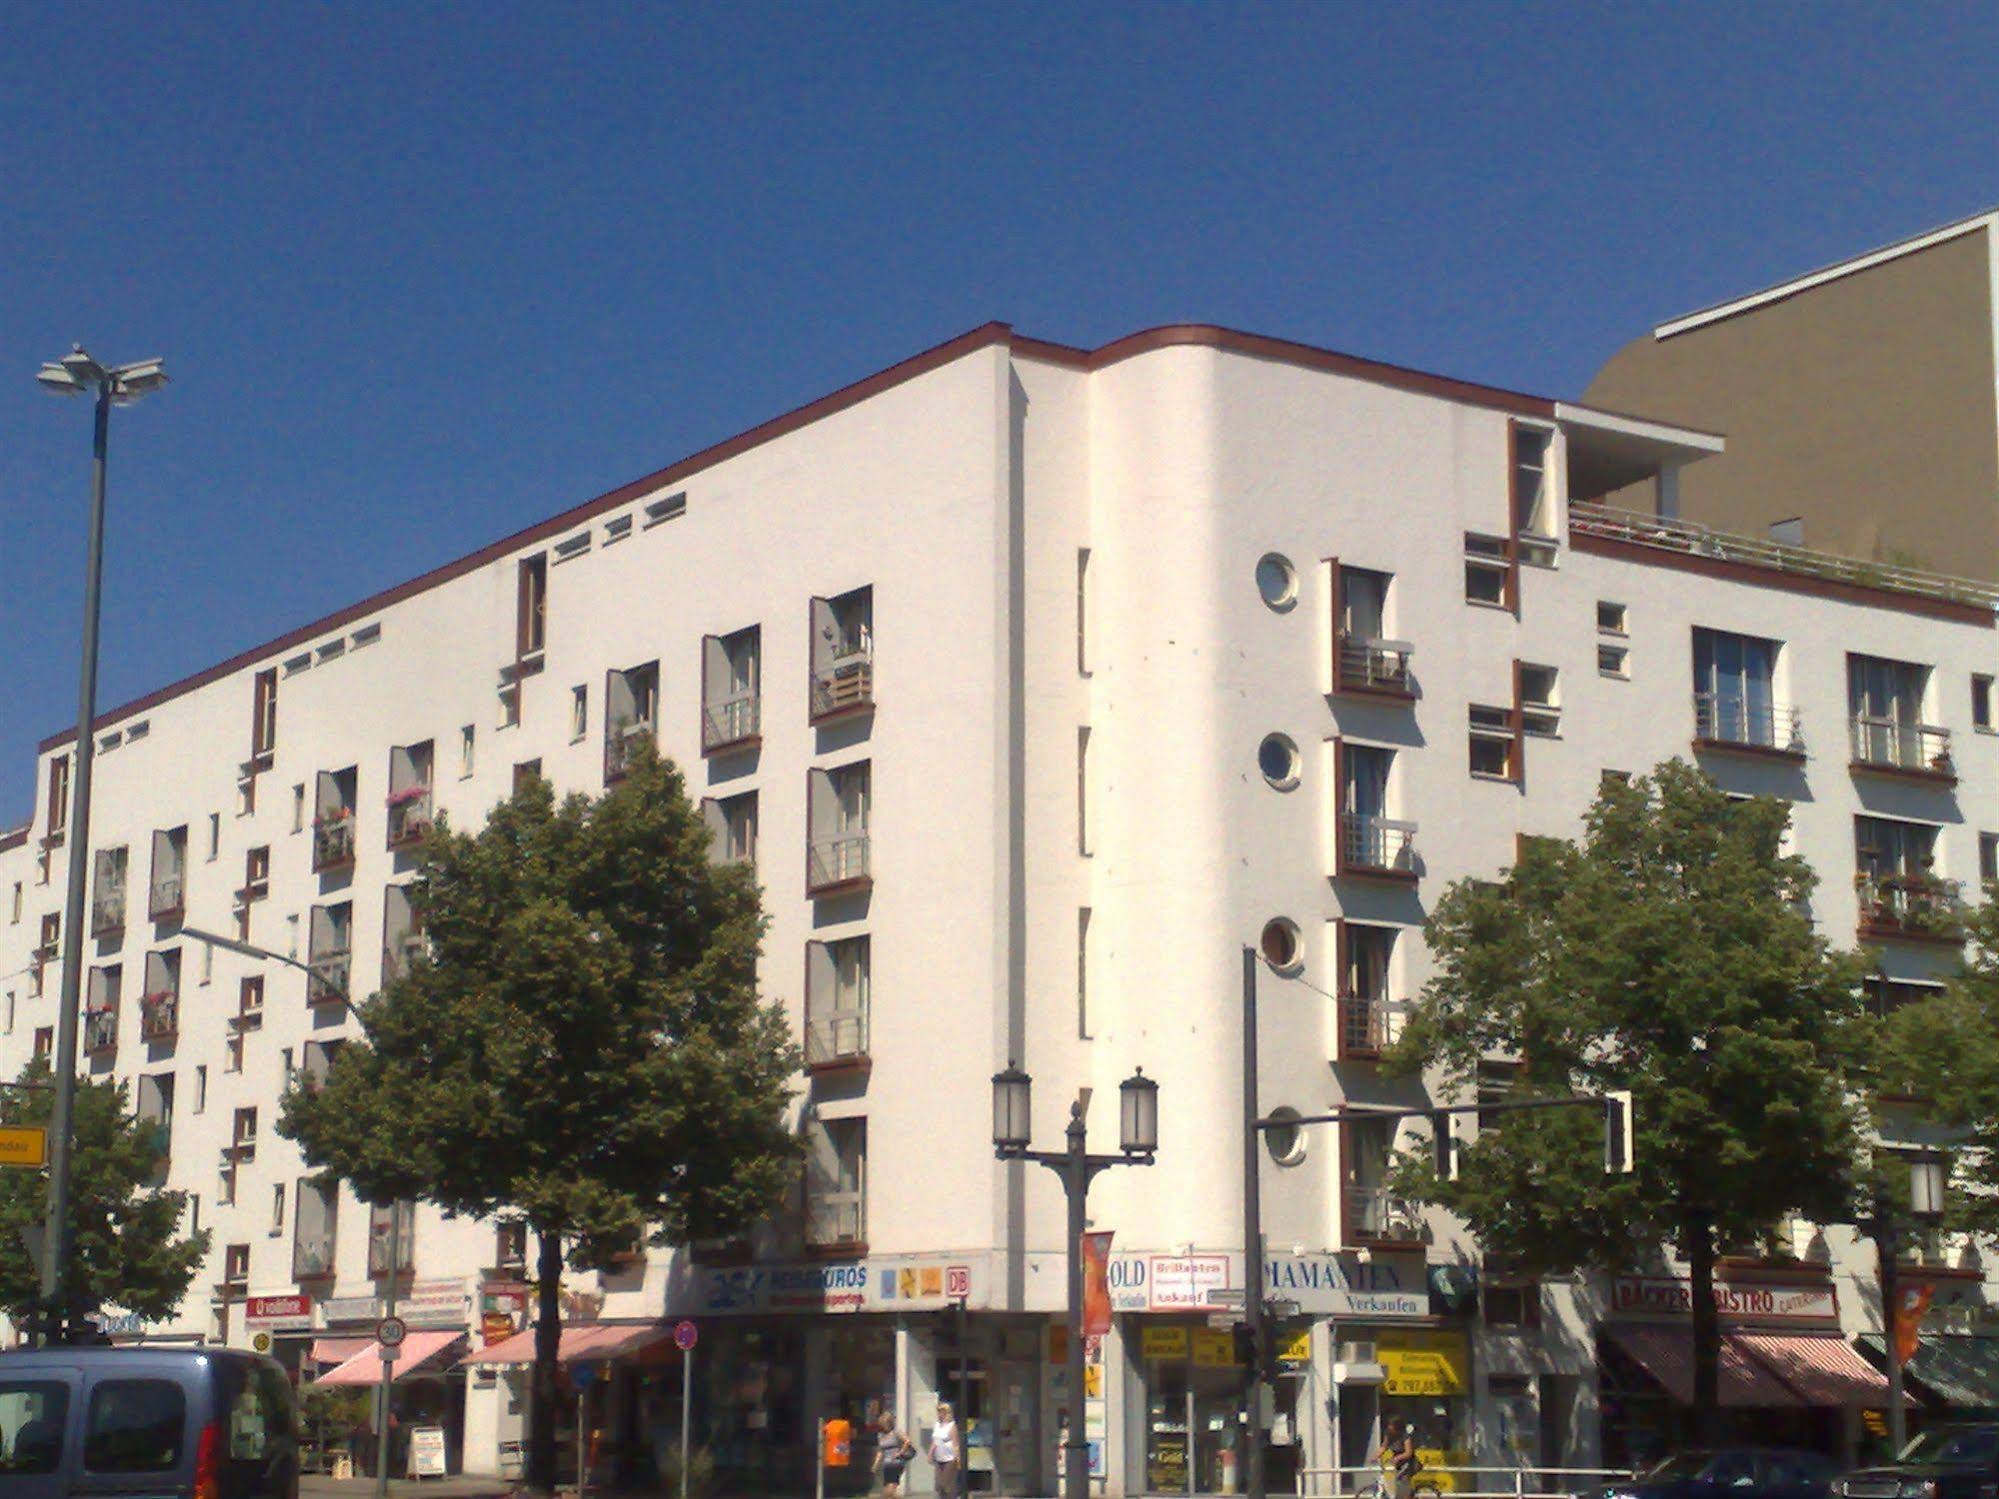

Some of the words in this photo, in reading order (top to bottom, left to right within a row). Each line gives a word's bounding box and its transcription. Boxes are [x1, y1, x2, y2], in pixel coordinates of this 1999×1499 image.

[949, 1270, 967, 1291] DB
[1110, 1260, 1145, 1287] OLD
[1346, 1294, 1417, 1313] Verkaufen
